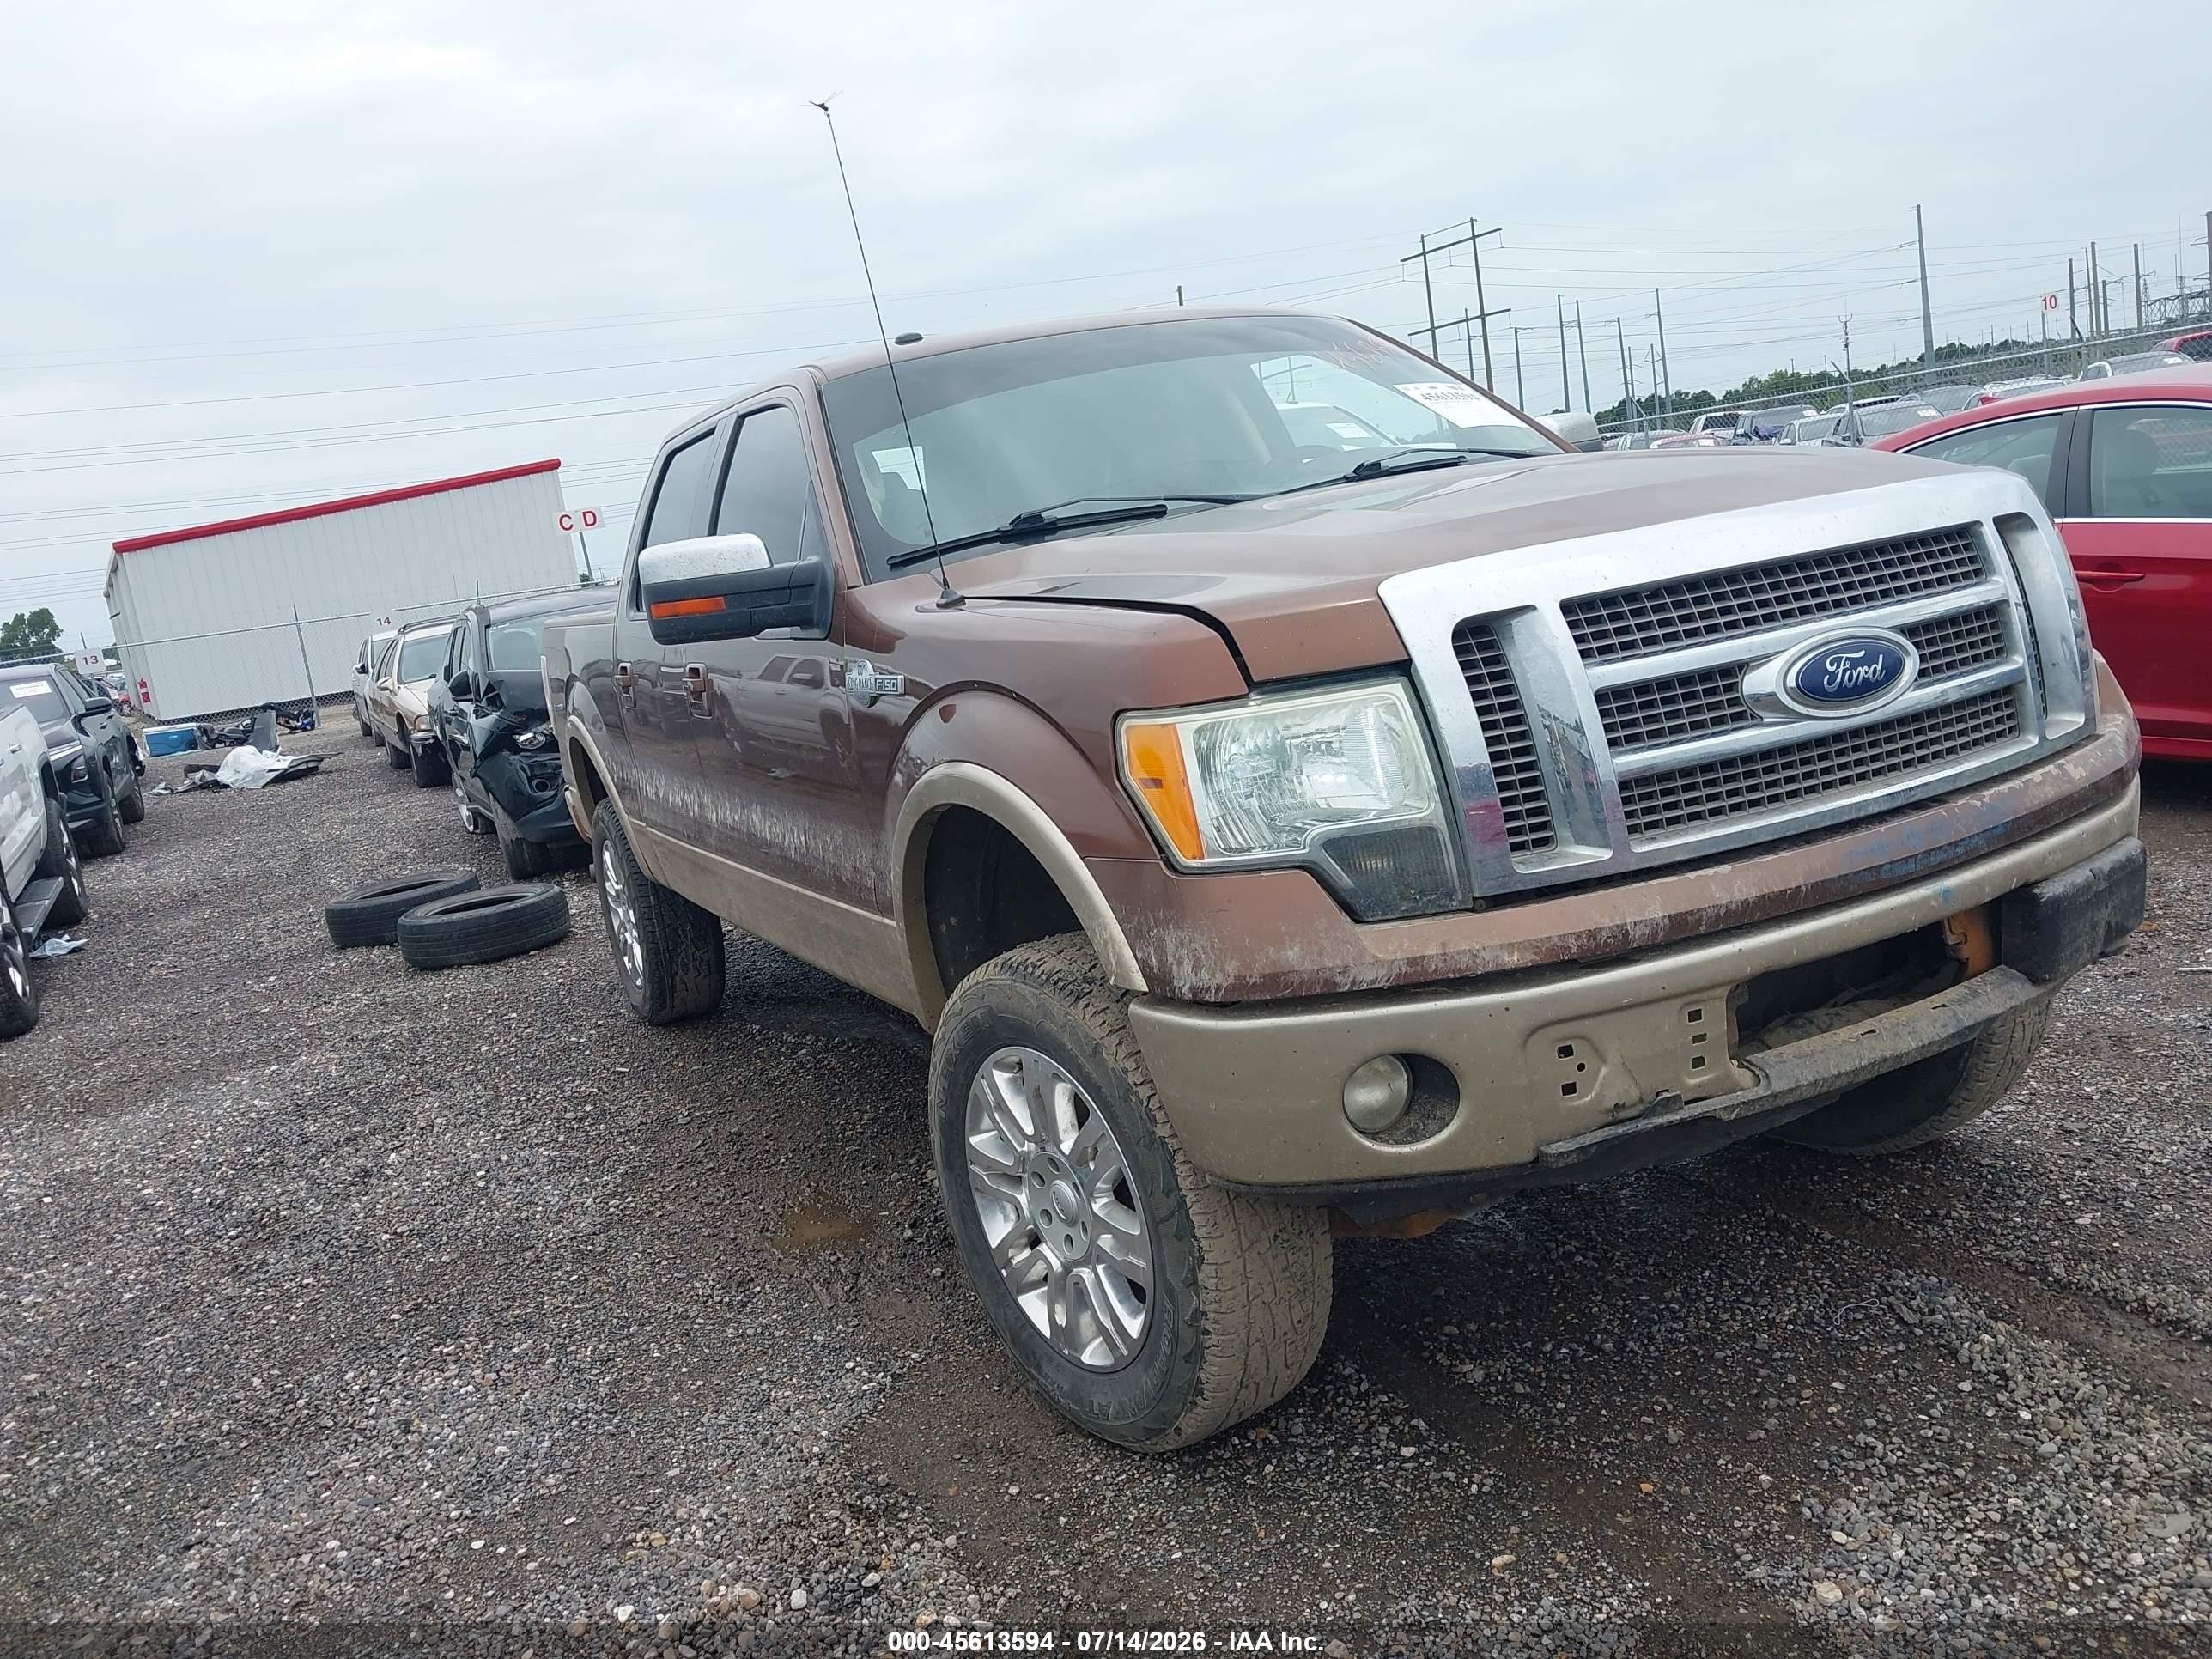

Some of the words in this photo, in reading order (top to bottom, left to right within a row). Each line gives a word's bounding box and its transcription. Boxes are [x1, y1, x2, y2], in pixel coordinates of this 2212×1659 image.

[2041, 295, 2057, 310] 10
[559, 514, 574, 531] C
[582, 510, 597, 527] D
[376, 617, 392, 626] 14
[82, 655, 99, 665] 13
[1823, 649, 1886, 692] Ford
